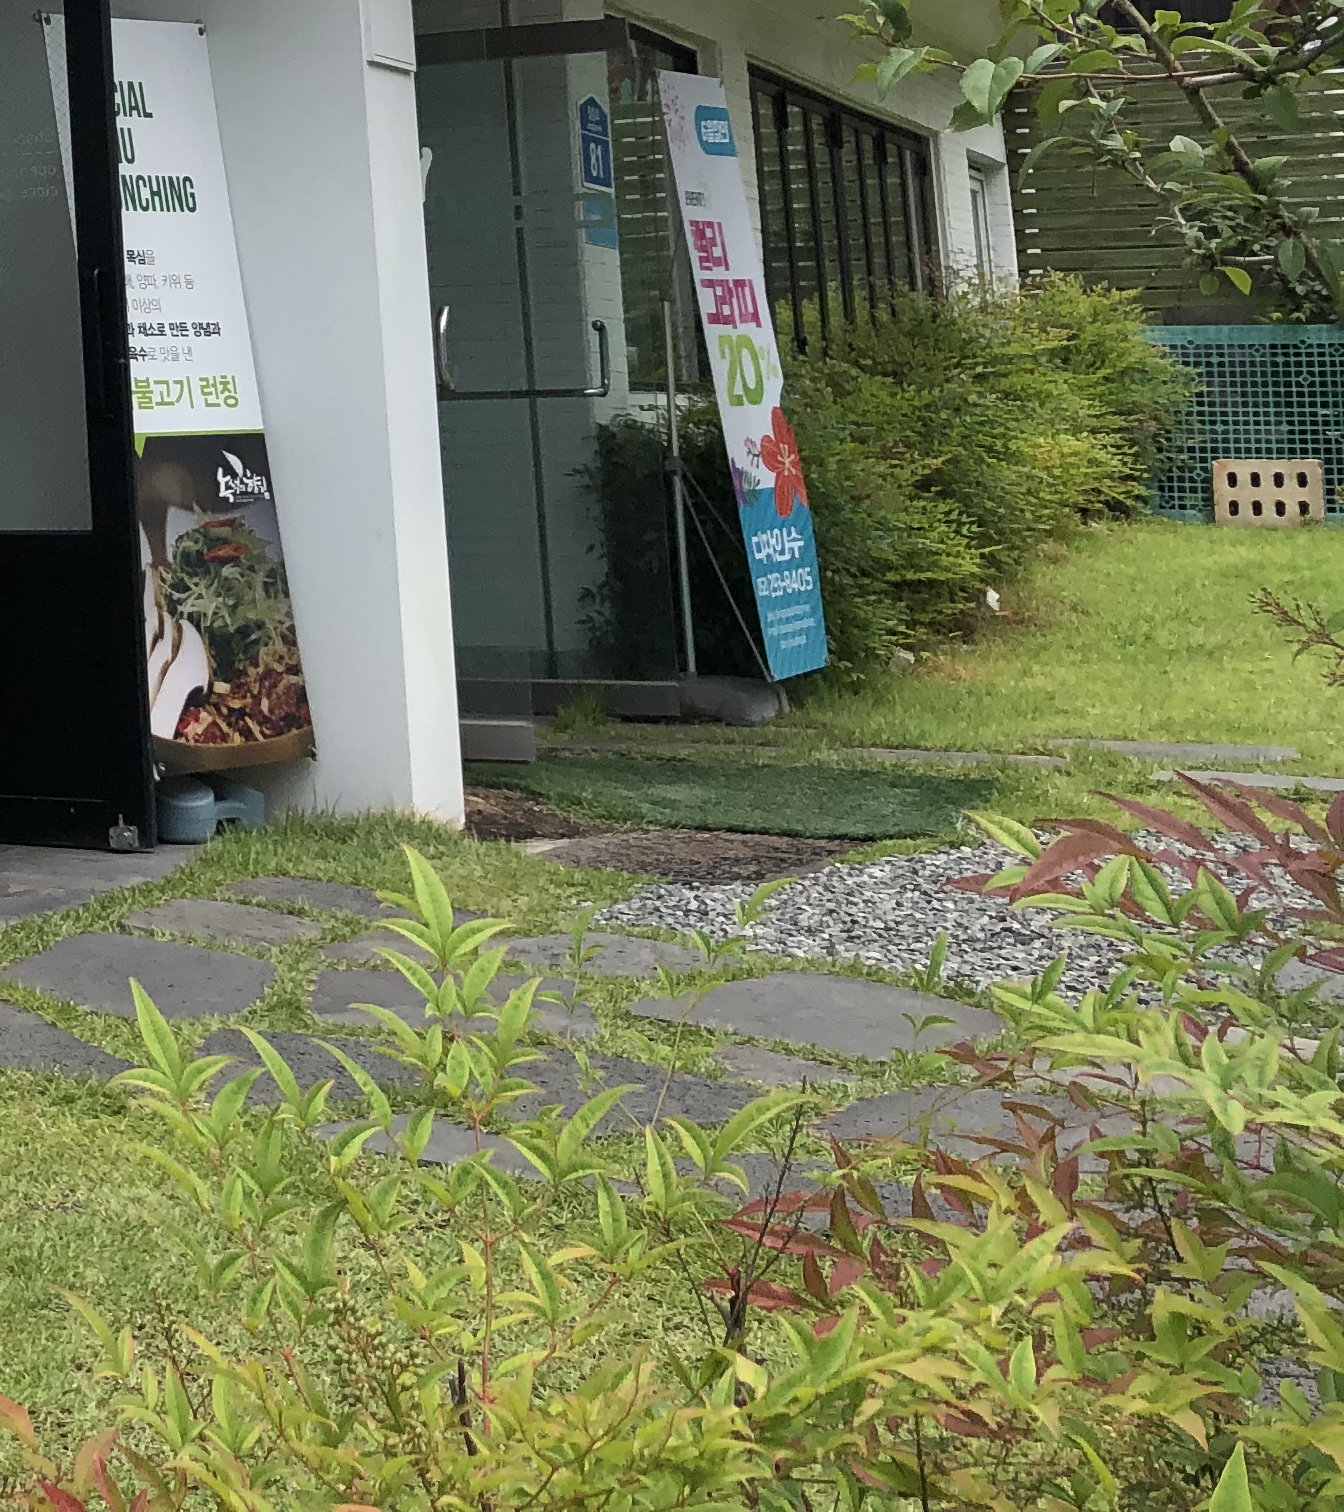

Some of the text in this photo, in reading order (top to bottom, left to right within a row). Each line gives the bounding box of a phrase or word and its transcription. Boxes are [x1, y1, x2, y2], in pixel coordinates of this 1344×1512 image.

[589, 142, 604, 178] 81
[126, 249, 155, 265] 목심을
[183, 274, 194, 289] 등
[132, 298, 162, 313] 이상의
[137, 322, 167, 337] 채소로
[169, 322, 189, 337] 만든
[192, 321, 221, 337] 양념과
[160, 346, 180, 362] 맛을
[199, 374, 239, 408] 런칭
